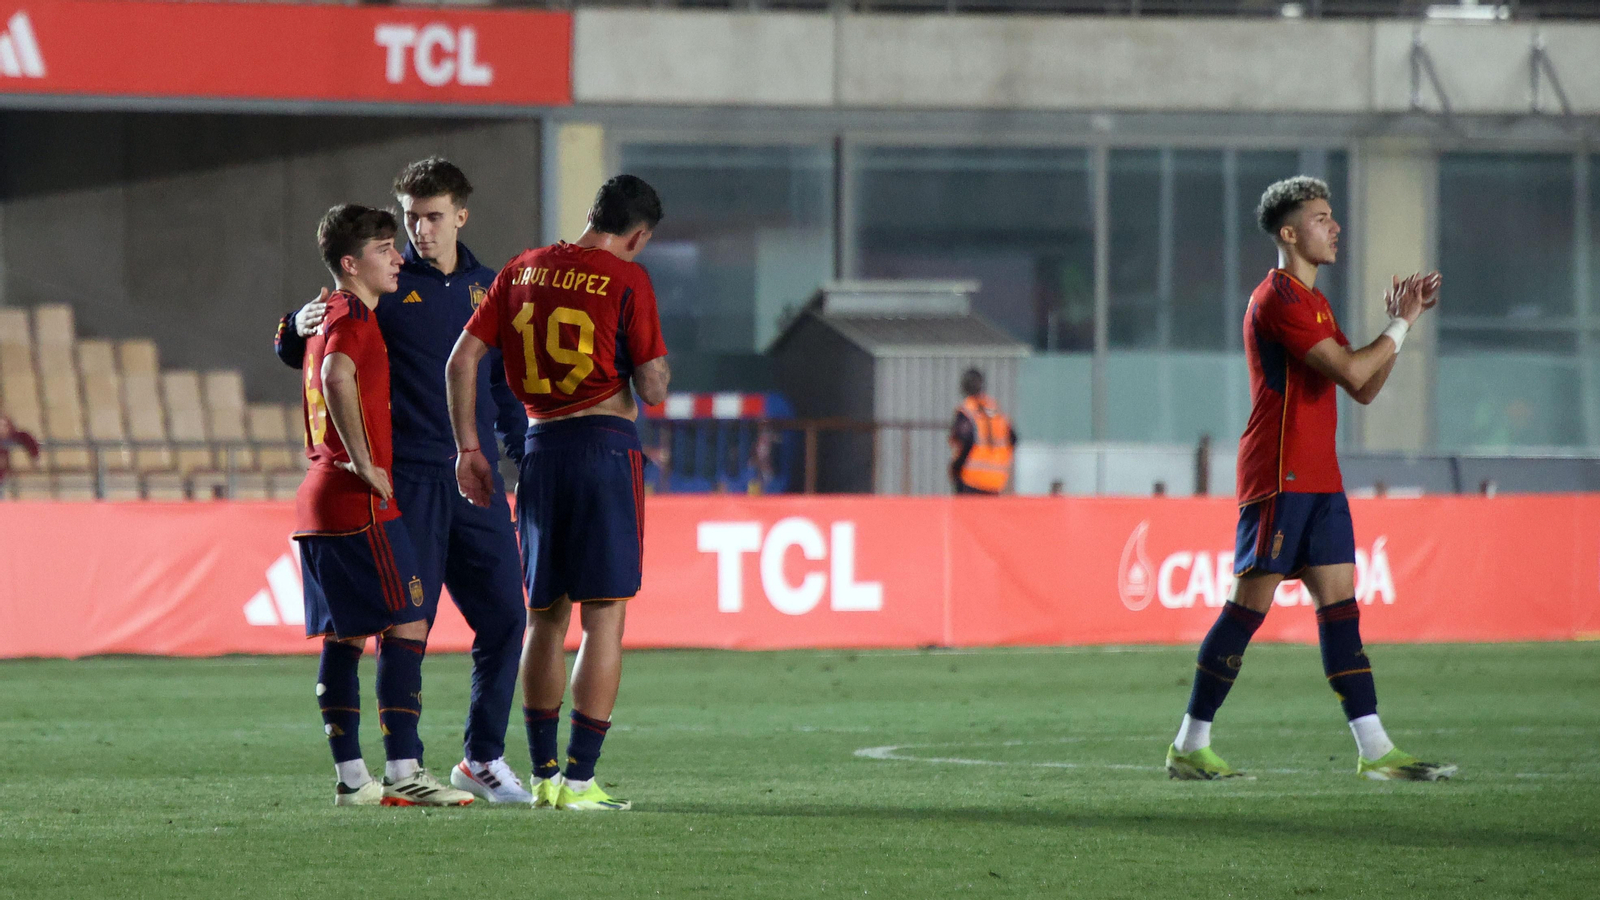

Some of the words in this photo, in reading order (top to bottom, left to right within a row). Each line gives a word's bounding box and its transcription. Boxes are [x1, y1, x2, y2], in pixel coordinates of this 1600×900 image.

[374, 23, 494, 87] TCL
[512, 266, 549, 286] JAVI
[552, 267, 610, 296] LÓPEZ
[511, 302, 595, 395] 19
[696, 516, 883, 615] TCL
